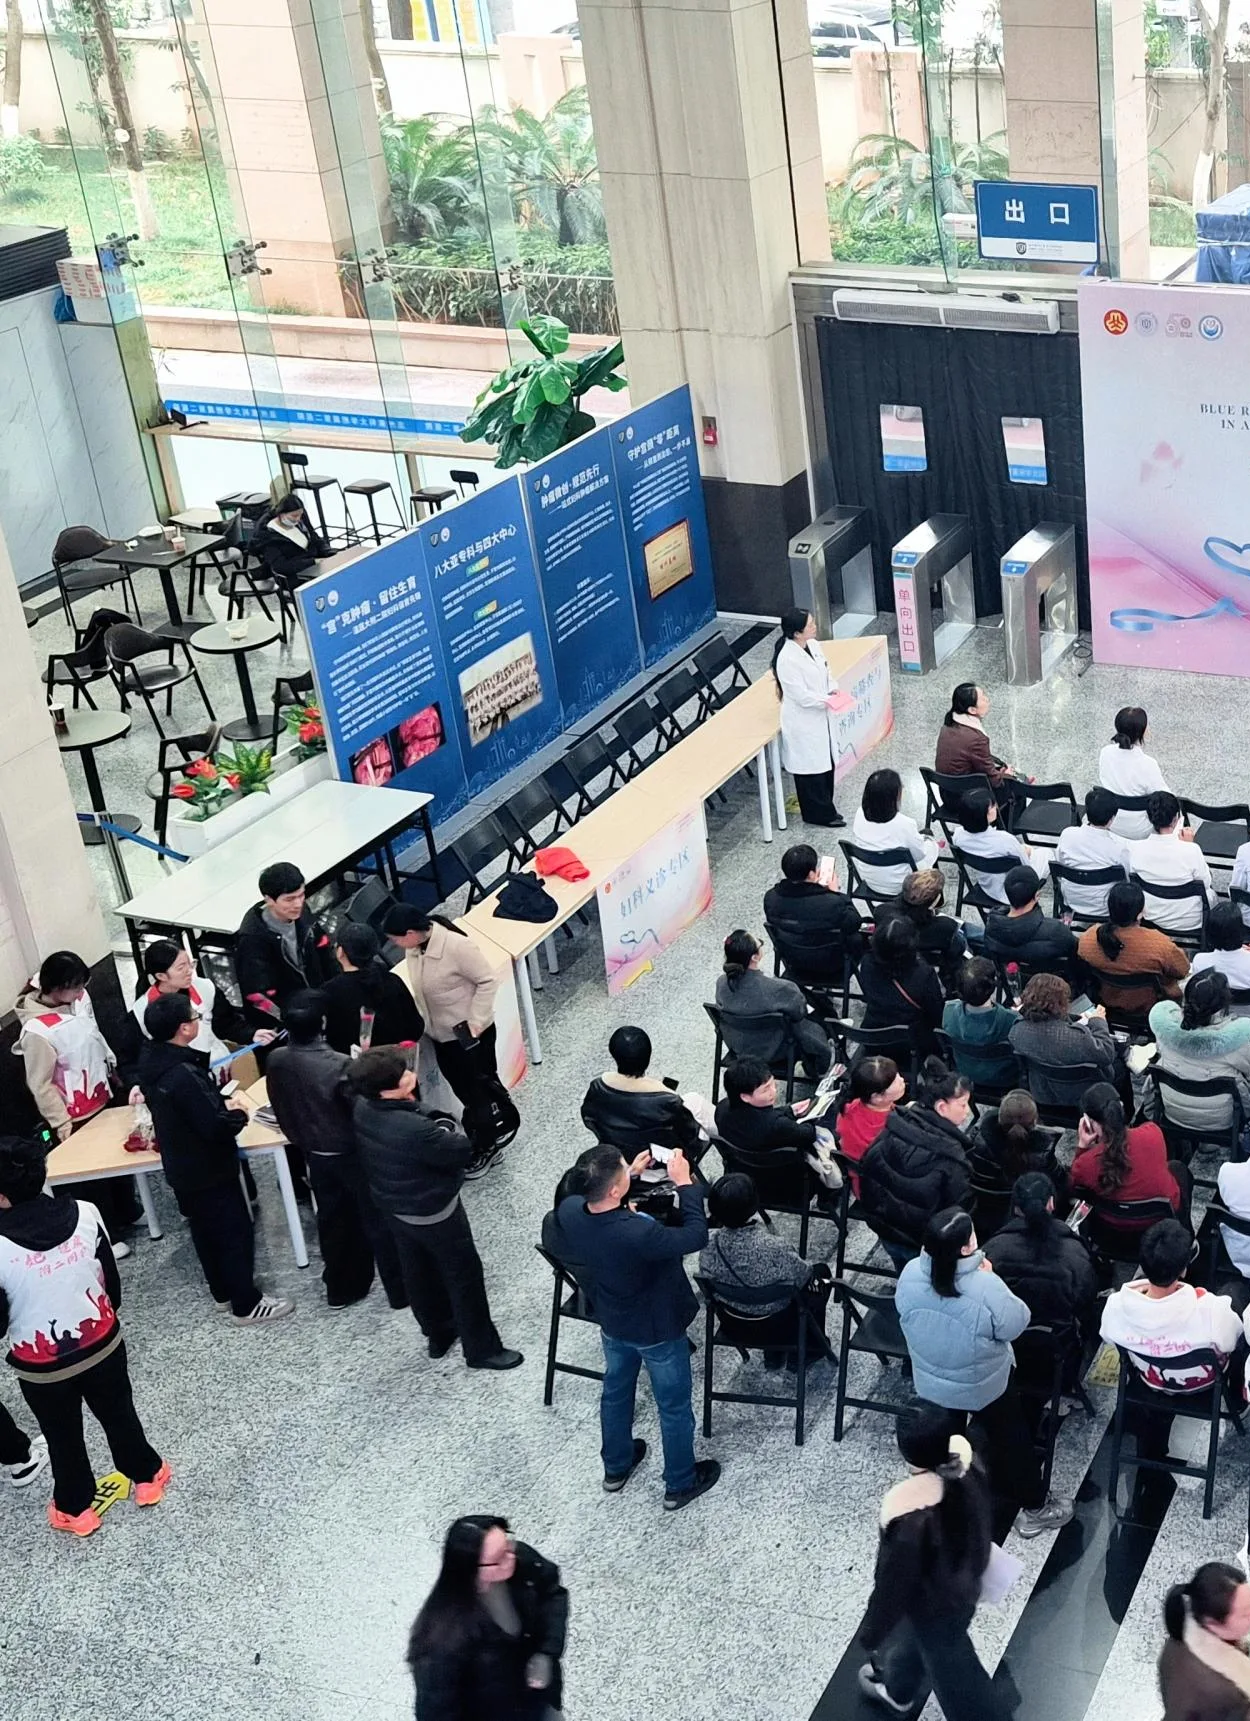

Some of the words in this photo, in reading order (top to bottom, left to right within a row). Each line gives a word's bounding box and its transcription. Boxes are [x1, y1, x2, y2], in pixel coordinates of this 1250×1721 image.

[1005, 198, 1070, 225] 出口
[1200, 403, 1235, 416] BLUE
[1221, 419, 1235, 429] IN
[898, 588, 915, 652] 单向出口
